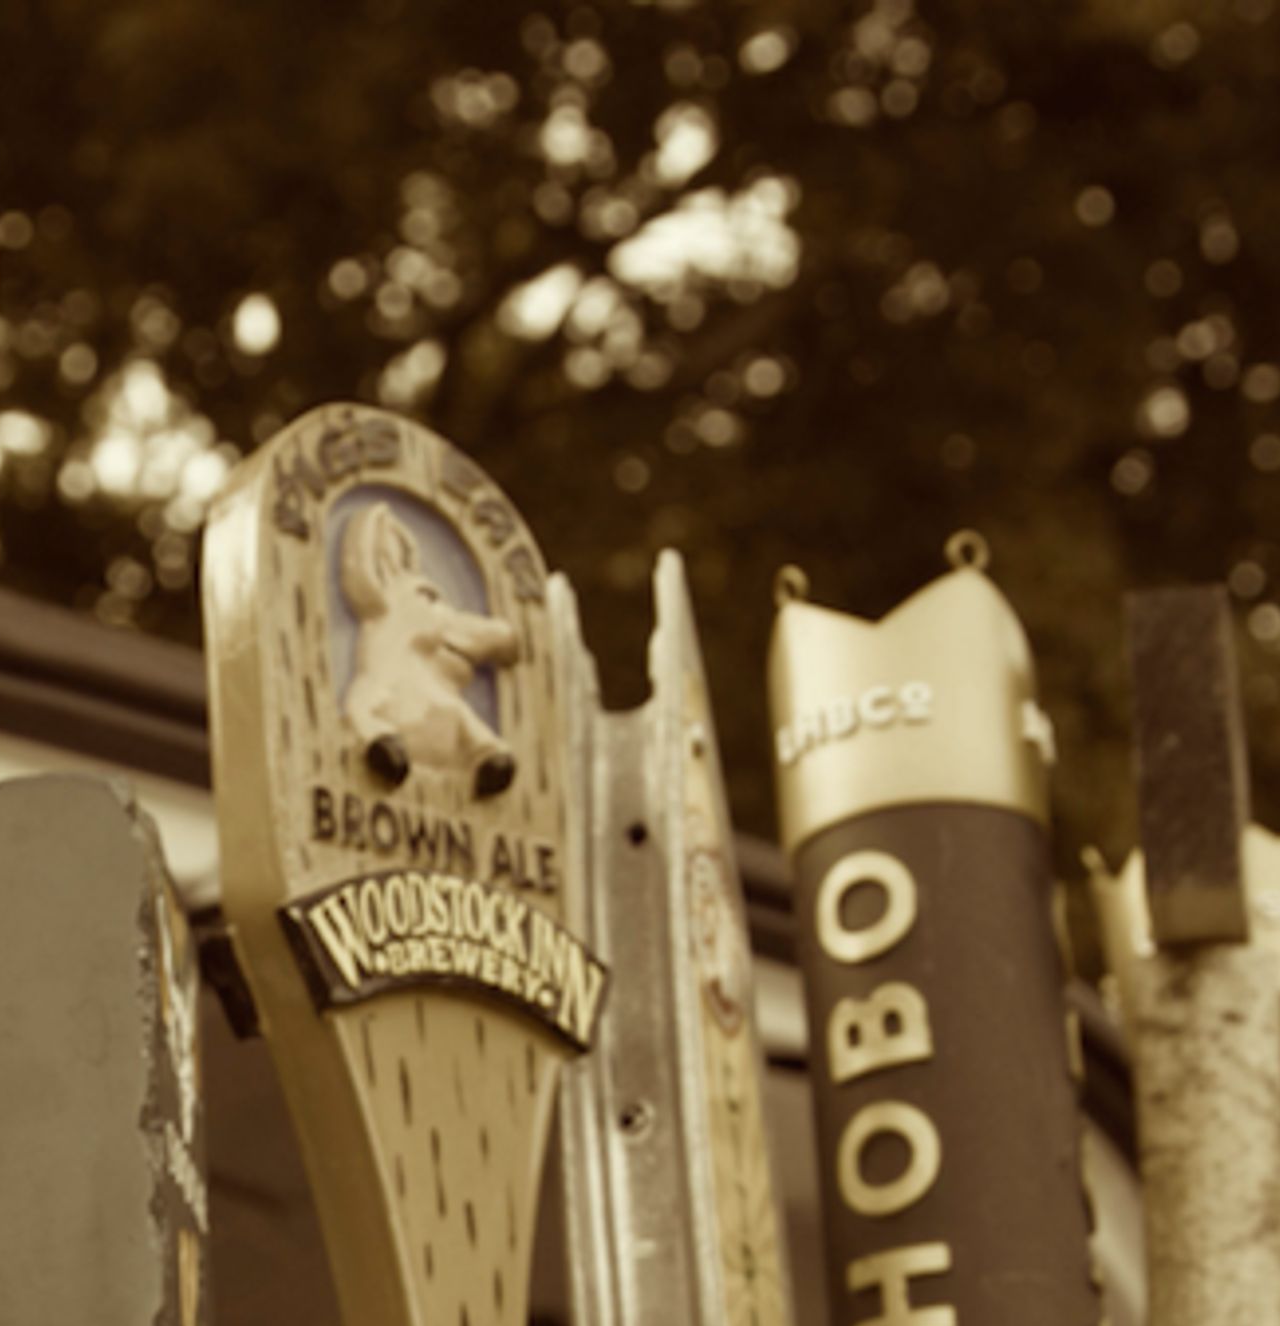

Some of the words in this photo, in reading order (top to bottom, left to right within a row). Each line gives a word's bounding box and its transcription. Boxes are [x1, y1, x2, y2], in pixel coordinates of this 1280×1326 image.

[311, 786, 477, 876] BROWN
[490, 834, 561, 896] ALE
[308, 872, 528, 989] WOODSTOCK
[526, 909, 606, 1044] INN
